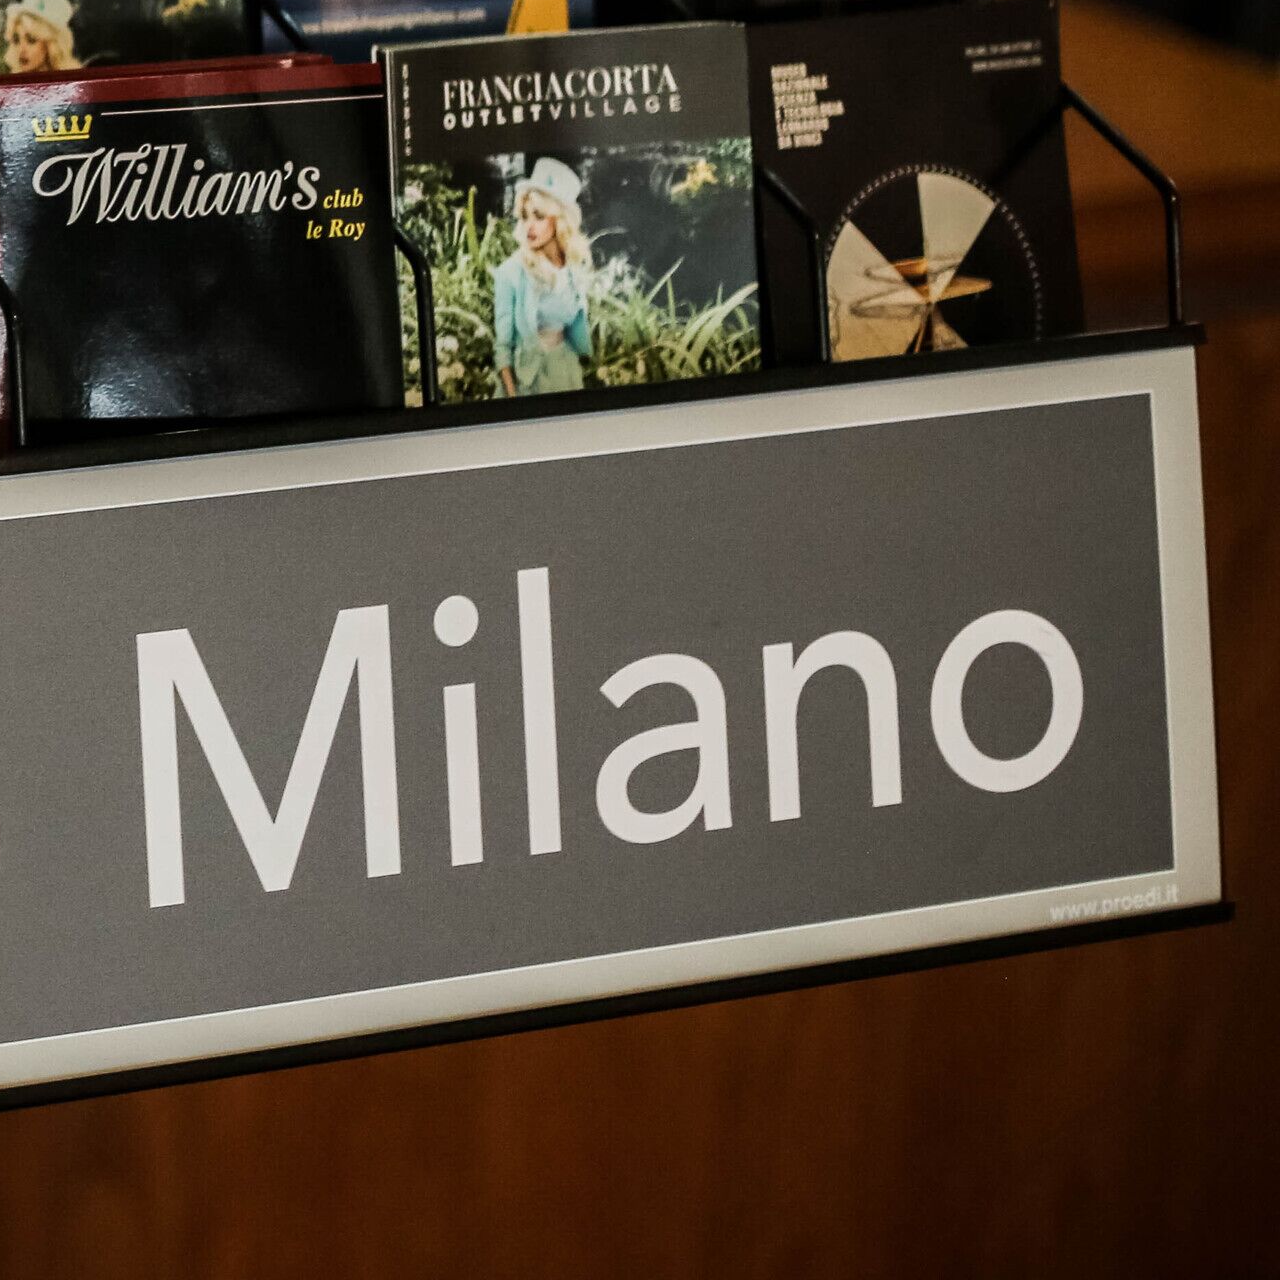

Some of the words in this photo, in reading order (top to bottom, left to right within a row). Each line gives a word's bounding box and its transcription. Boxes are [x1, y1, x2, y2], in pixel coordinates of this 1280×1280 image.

[443, 64, 679, 109] FRANCIACORTA
[32, 143, 321, 226] William's
[323, 189, 363, 212] club
[307, 219, 323, 240] le
[328, 217, 365, 241] Roy
[135, 565, 1086, 911] Milano
